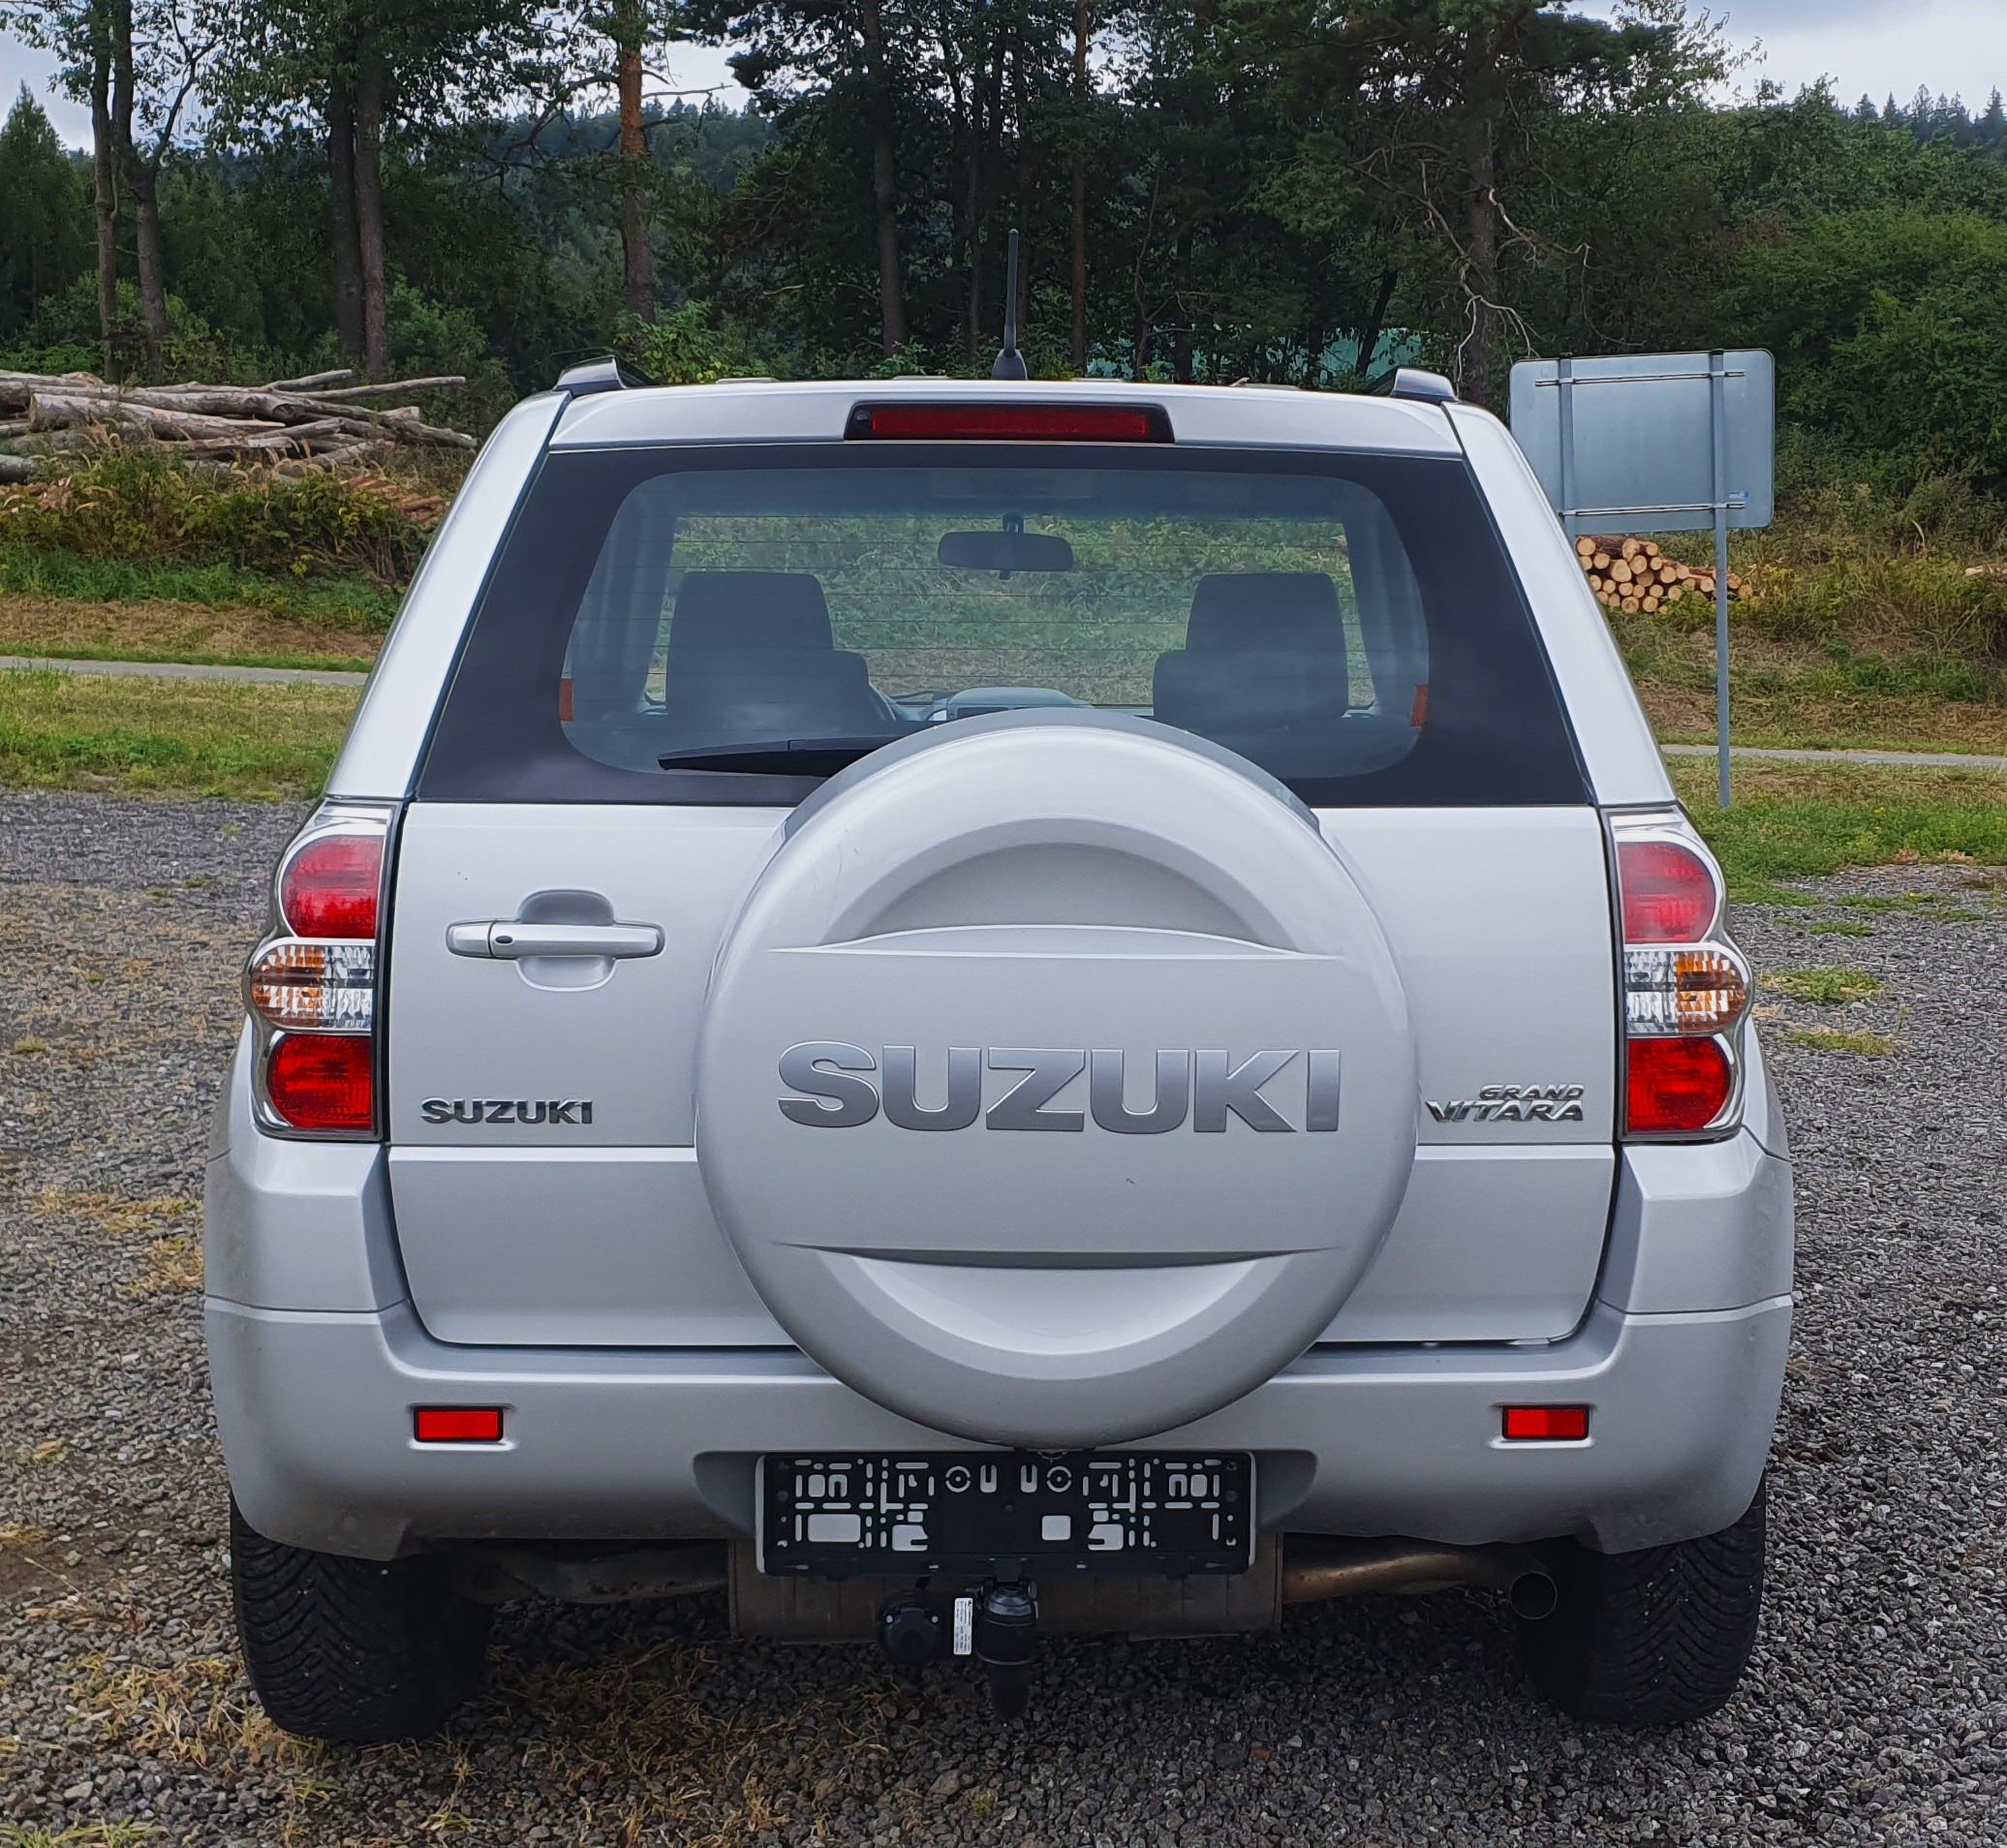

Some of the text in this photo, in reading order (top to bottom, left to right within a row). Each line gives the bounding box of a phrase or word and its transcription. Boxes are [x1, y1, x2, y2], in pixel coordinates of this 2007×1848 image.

[777, 1040, 1342, 1134] SUZUKI
[1479, 1084, 1585, 1100] GRAND
[420, 1096, 593, 1124] SUZUKI
[1425, 1099, 1584, 1123] VITARA
